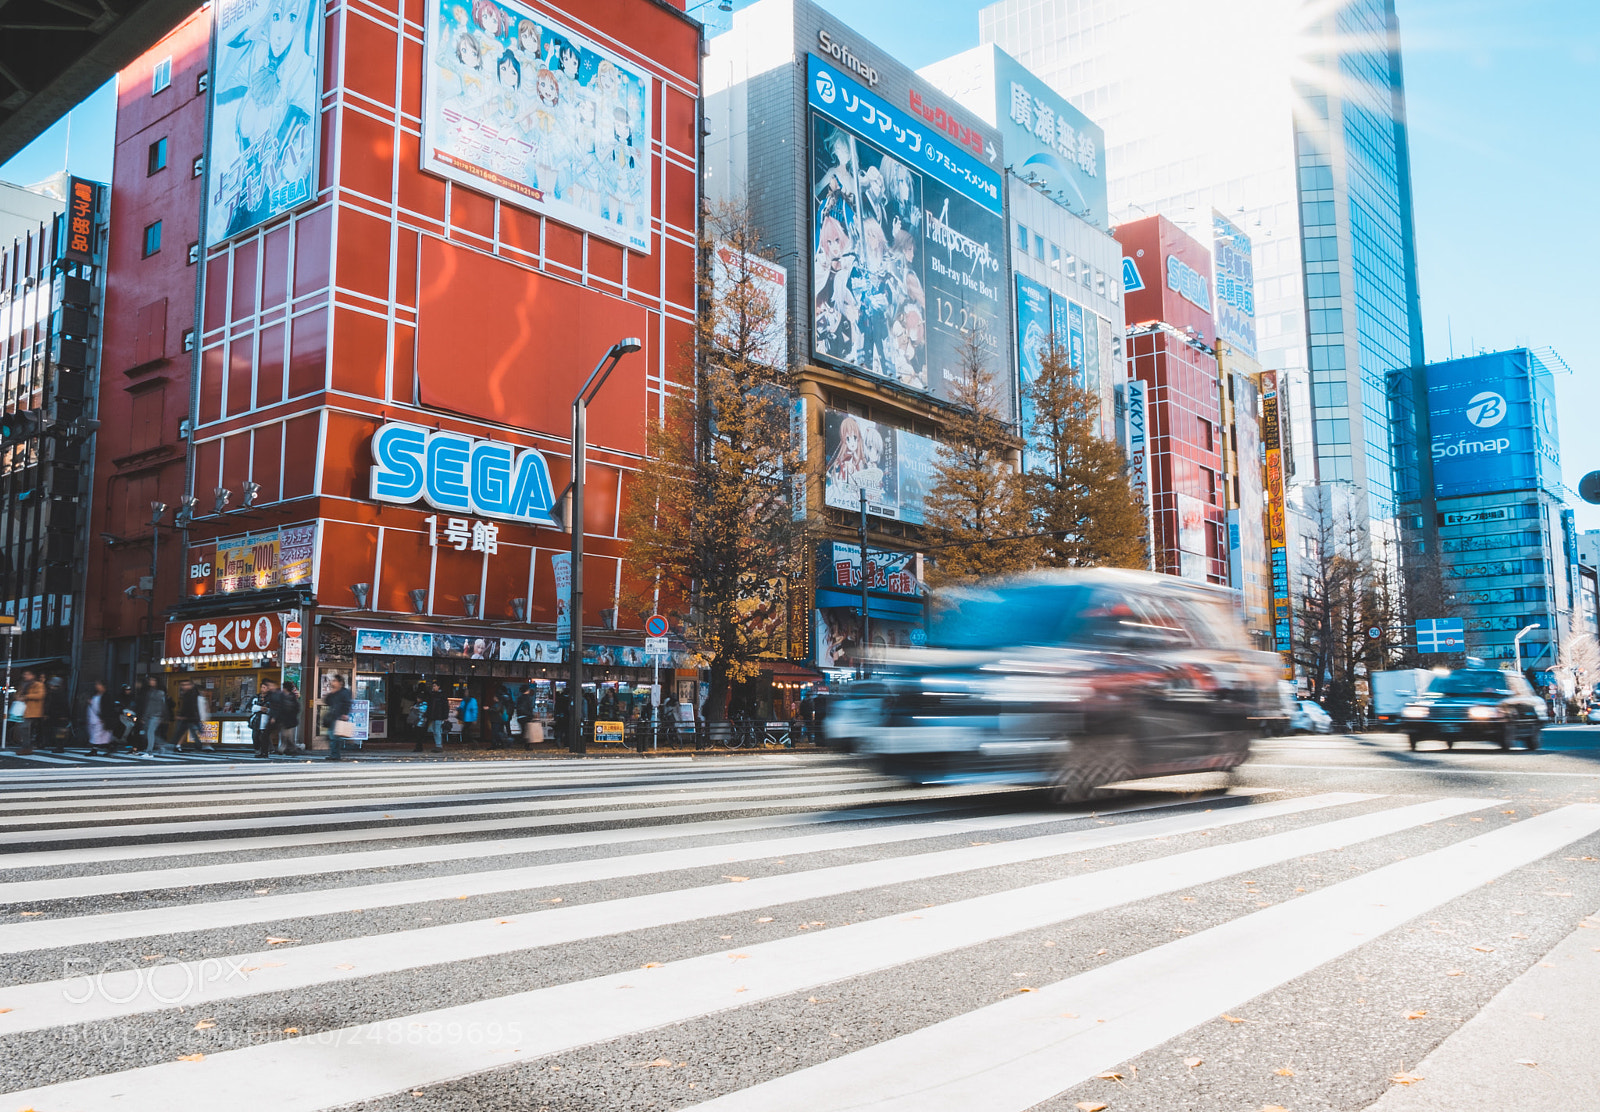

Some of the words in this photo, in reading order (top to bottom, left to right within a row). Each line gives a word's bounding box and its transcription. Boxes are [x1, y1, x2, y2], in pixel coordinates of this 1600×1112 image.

[818, 29, 879, 87] Sofmap
[842, 87, 922, 153] ソフマップ
[909, 88, 983, 155] ビックカメラ
[71, 182, 92, 253] 電子部品
[269, 176, 308, 214] SEGA
[931, 256, 960, 285] Blu-ray
[962, 271, 978, 291] Disc
[979, 280, 993, 299] Box
[1166, 253, 1211, 315] SEGA
[1129, 386, 1144, 433] AKKY
[1432, 437, 1510, 459] Sofmap
[370, 422, 562, 527] SEGA
[424, 515, 499, 555] 1号館
[190, 562, 212, 579] BIG
[198, 619, 252, 654] 宝くじ
